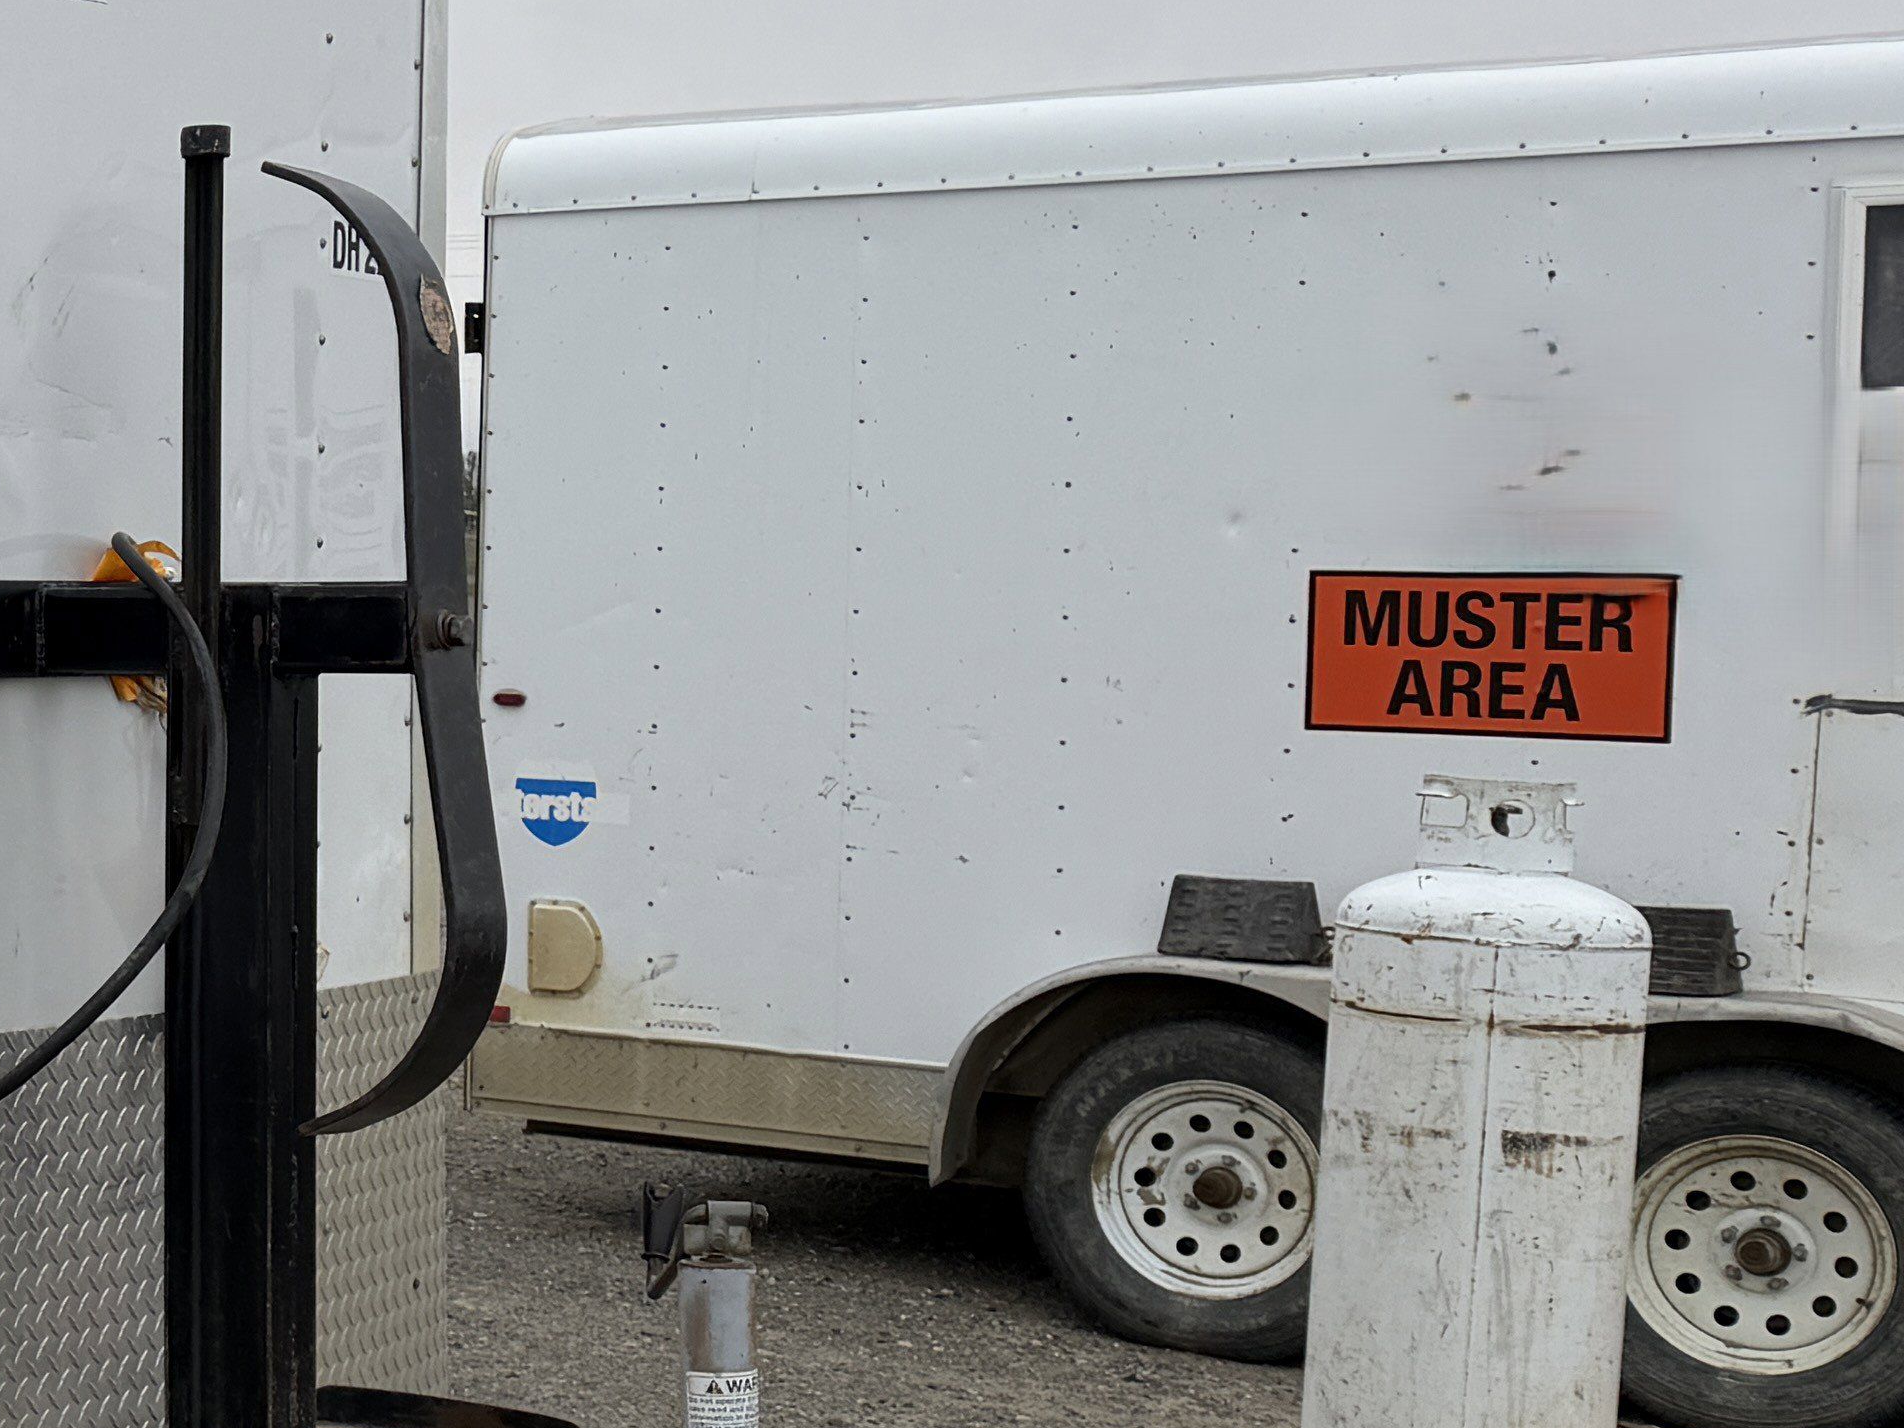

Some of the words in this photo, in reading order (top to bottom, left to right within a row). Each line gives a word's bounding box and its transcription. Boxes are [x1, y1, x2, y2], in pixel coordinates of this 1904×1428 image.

[332, 220, 361, 272] DH
[1343, 588, 1634, 653] MUSTER
[1386, 659, 1581, 722] AREA
